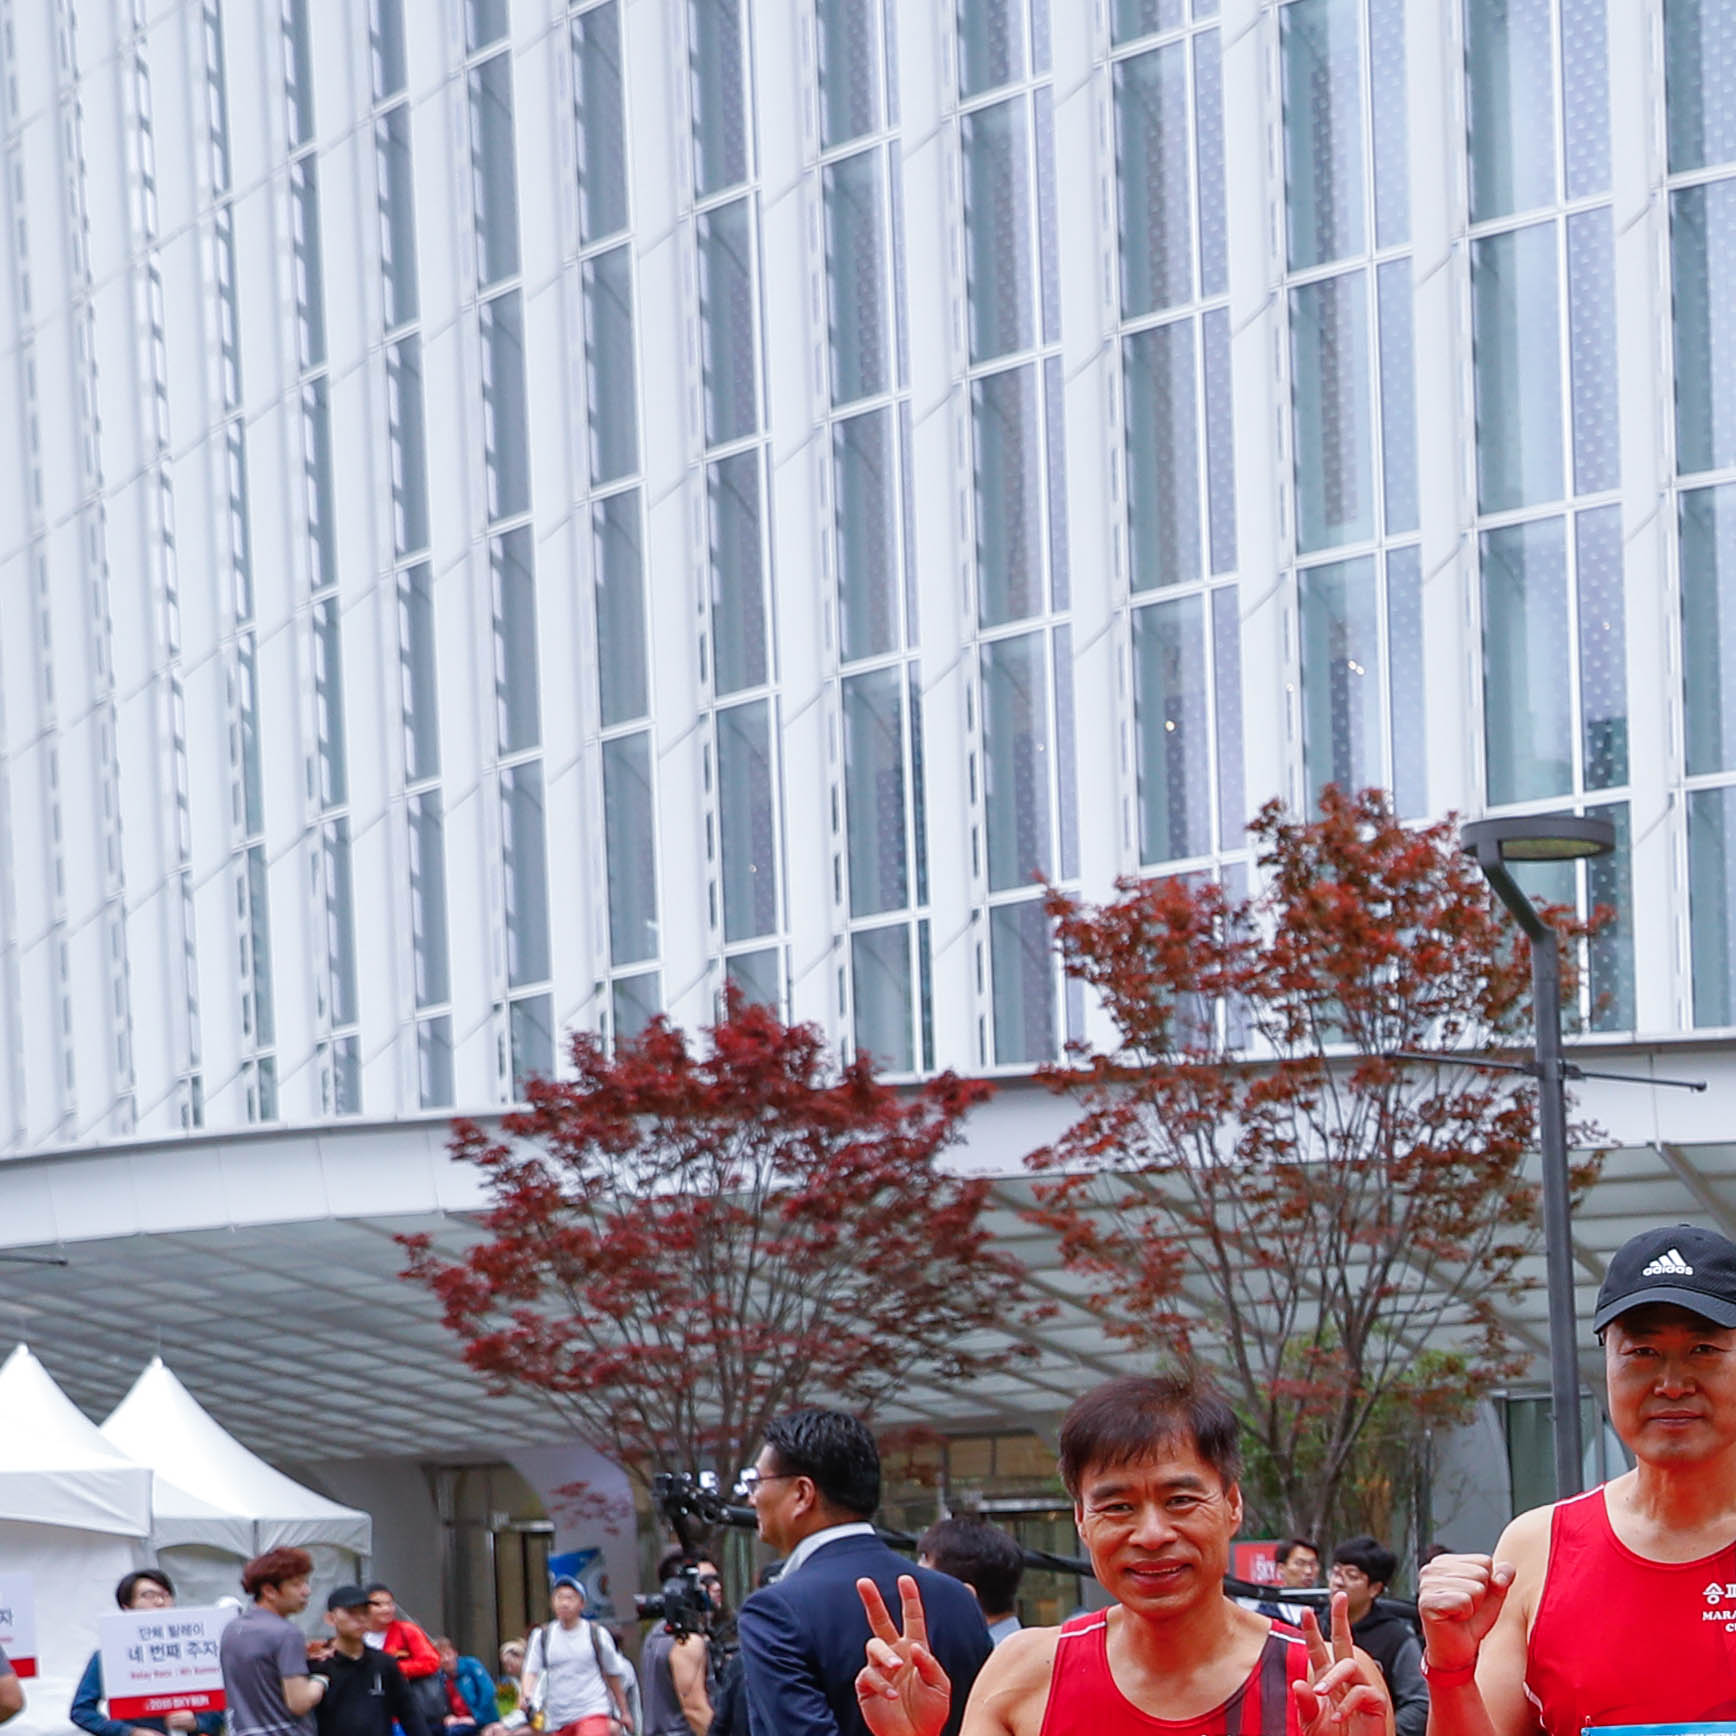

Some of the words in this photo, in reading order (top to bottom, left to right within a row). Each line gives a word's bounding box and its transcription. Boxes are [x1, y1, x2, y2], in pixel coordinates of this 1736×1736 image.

[1642, 1265, 1694, 1277] adidas
[128, 1646, 144, 1663] 네
[150, 1642, 181, 1662] 번째
[188, 1640, 219, 1660] 주자
